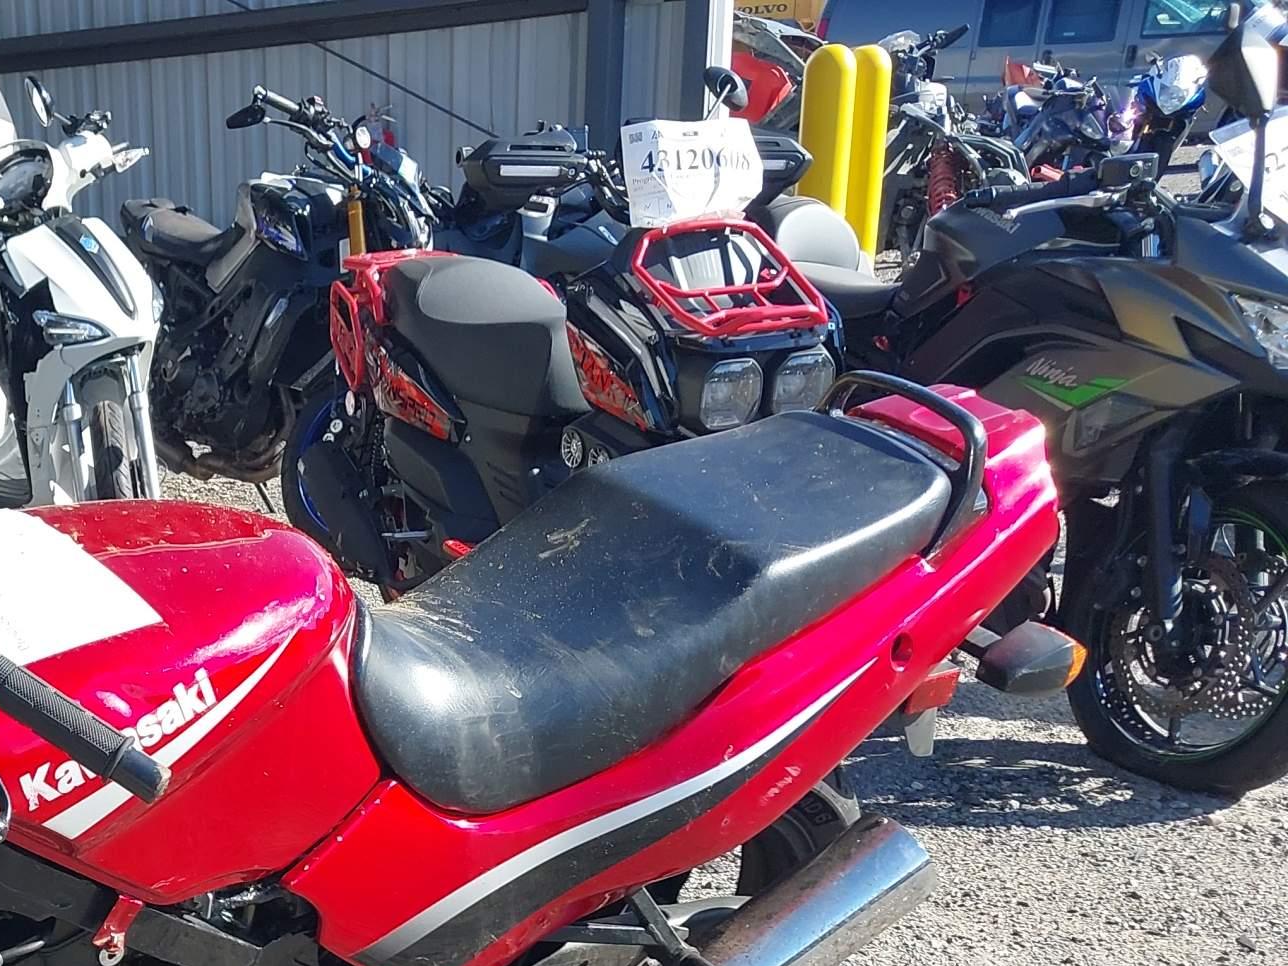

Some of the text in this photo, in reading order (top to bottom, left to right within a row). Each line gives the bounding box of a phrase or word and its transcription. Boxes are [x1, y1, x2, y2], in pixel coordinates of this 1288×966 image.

[640, 146, 751, 174] 43120608
[1025, 357, 1078, 388] Ninja
[18, 666, 218, 812] Kaasaki
